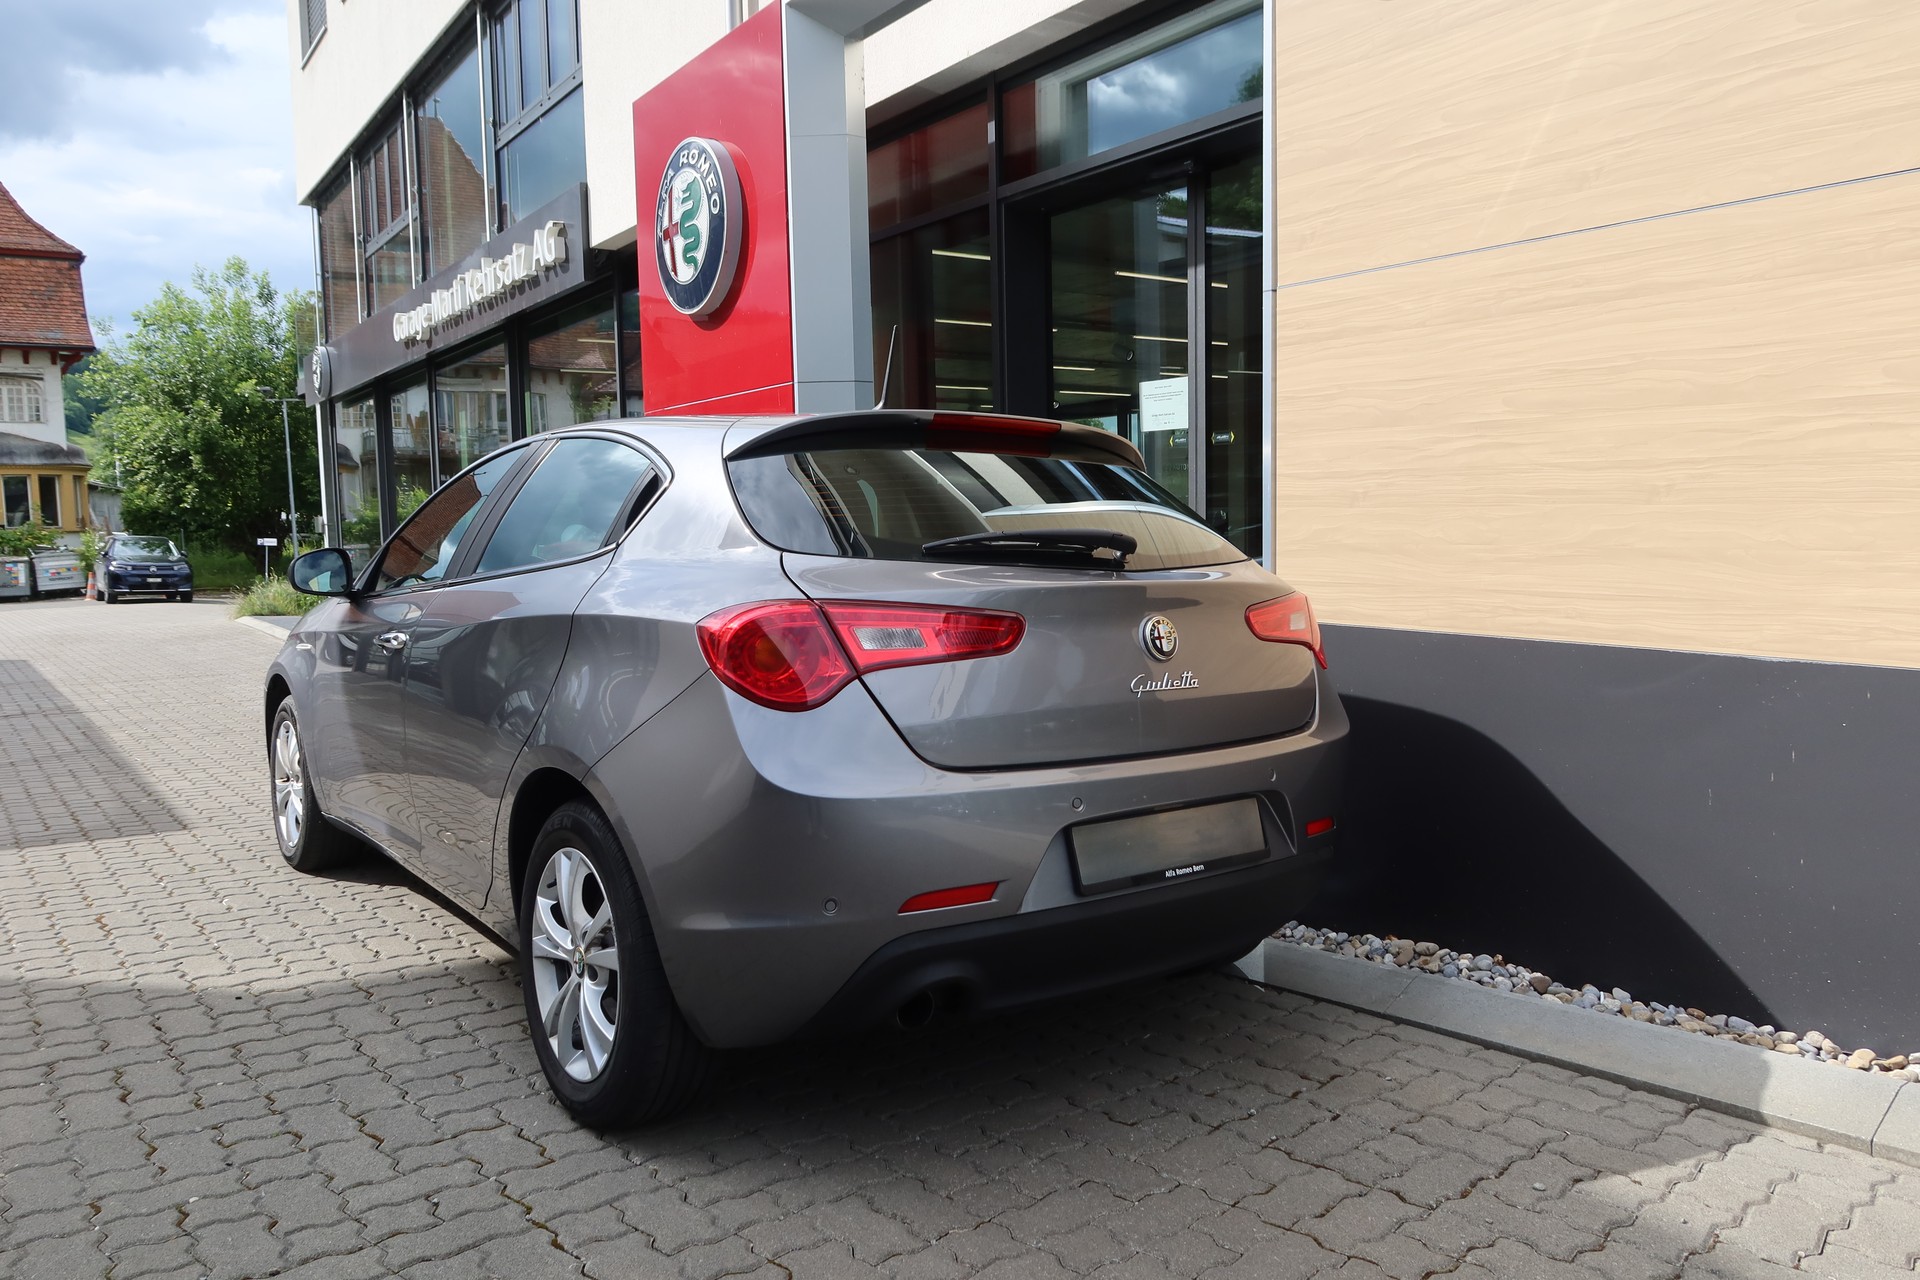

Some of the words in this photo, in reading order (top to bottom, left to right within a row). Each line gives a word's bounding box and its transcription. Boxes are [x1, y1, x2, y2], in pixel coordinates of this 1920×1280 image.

[679, 149, 720, 215] ROMEO
[393, 304, 430, 342] Garage
[465, 243, 529, 304] Kehrsatz
[532, 220, 568, 271] AG
[1130, 671, 1200, 698] Giulietta
[1165, 869, 1176, 878] Alfa
[1176, 866, 1193, 875] Romeo
[1193, 864, 1205, 872] Bern
